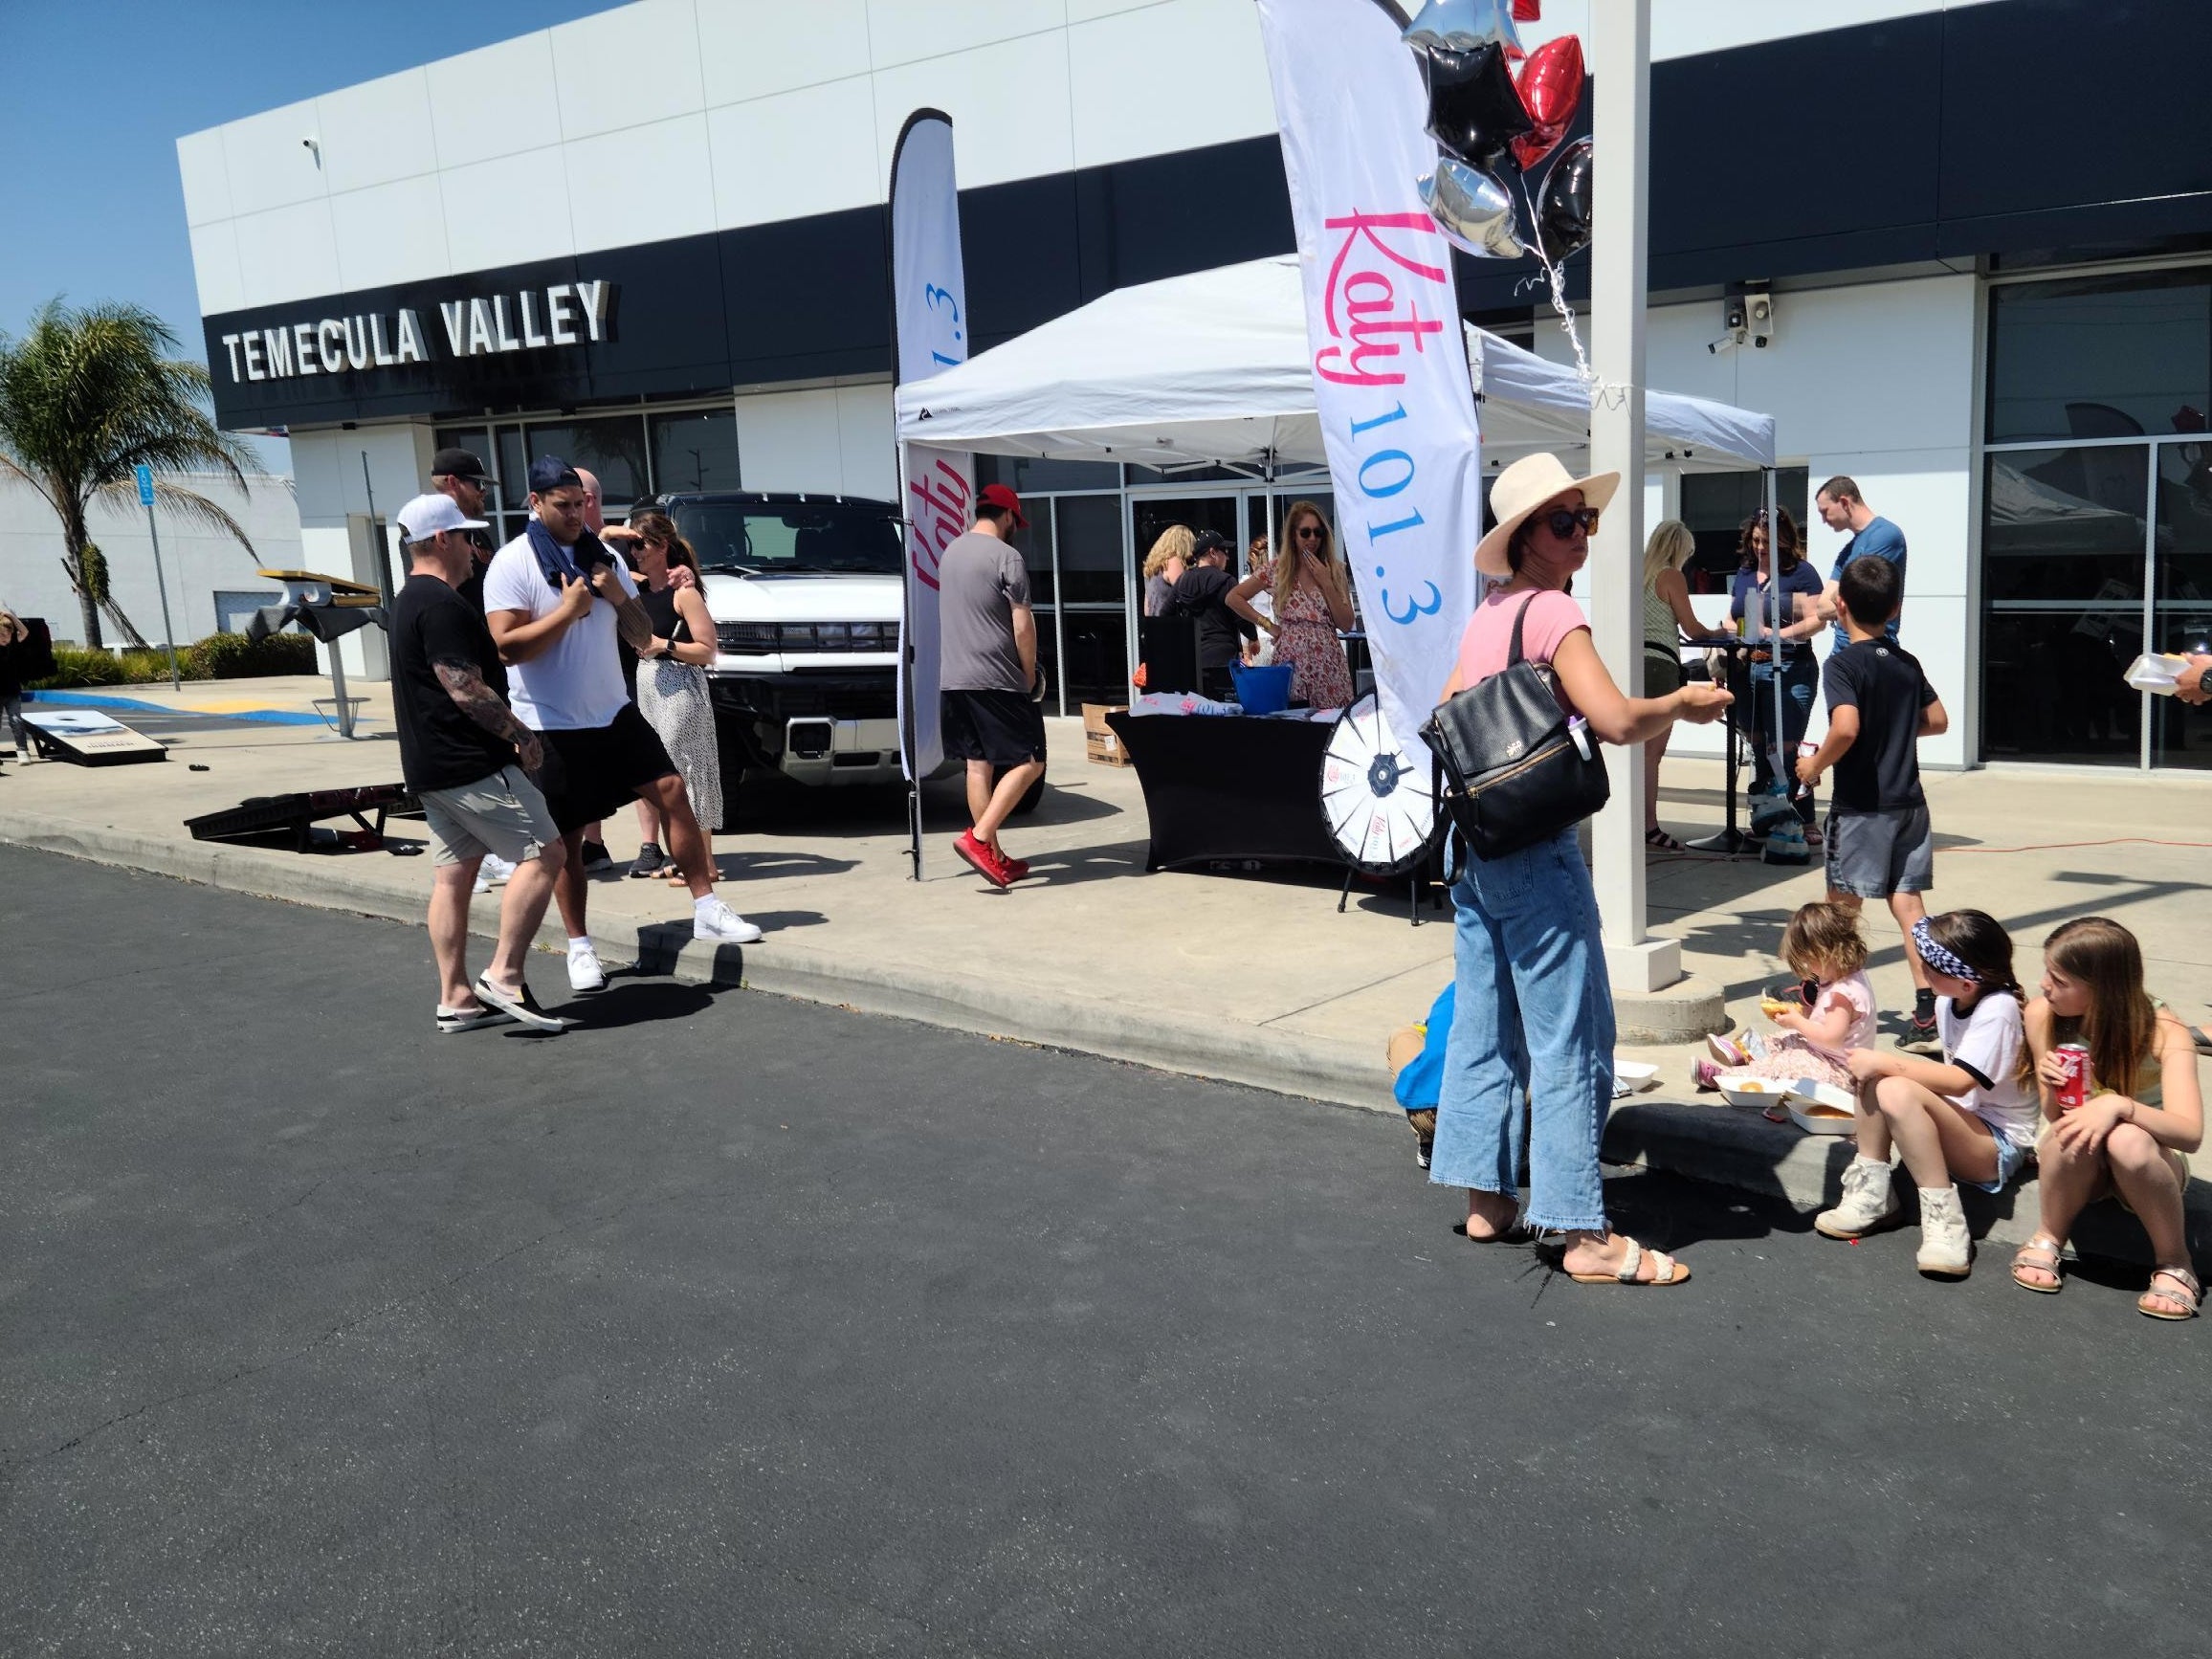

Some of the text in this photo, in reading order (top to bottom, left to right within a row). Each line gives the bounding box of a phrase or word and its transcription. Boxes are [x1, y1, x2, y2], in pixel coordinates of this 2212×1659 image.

[222, 279, 610, 384] TEMECULA VALLEY
[925, 282, 962, 366] 1.3
[1316, 207, 1447, 626] Katy 101.3
